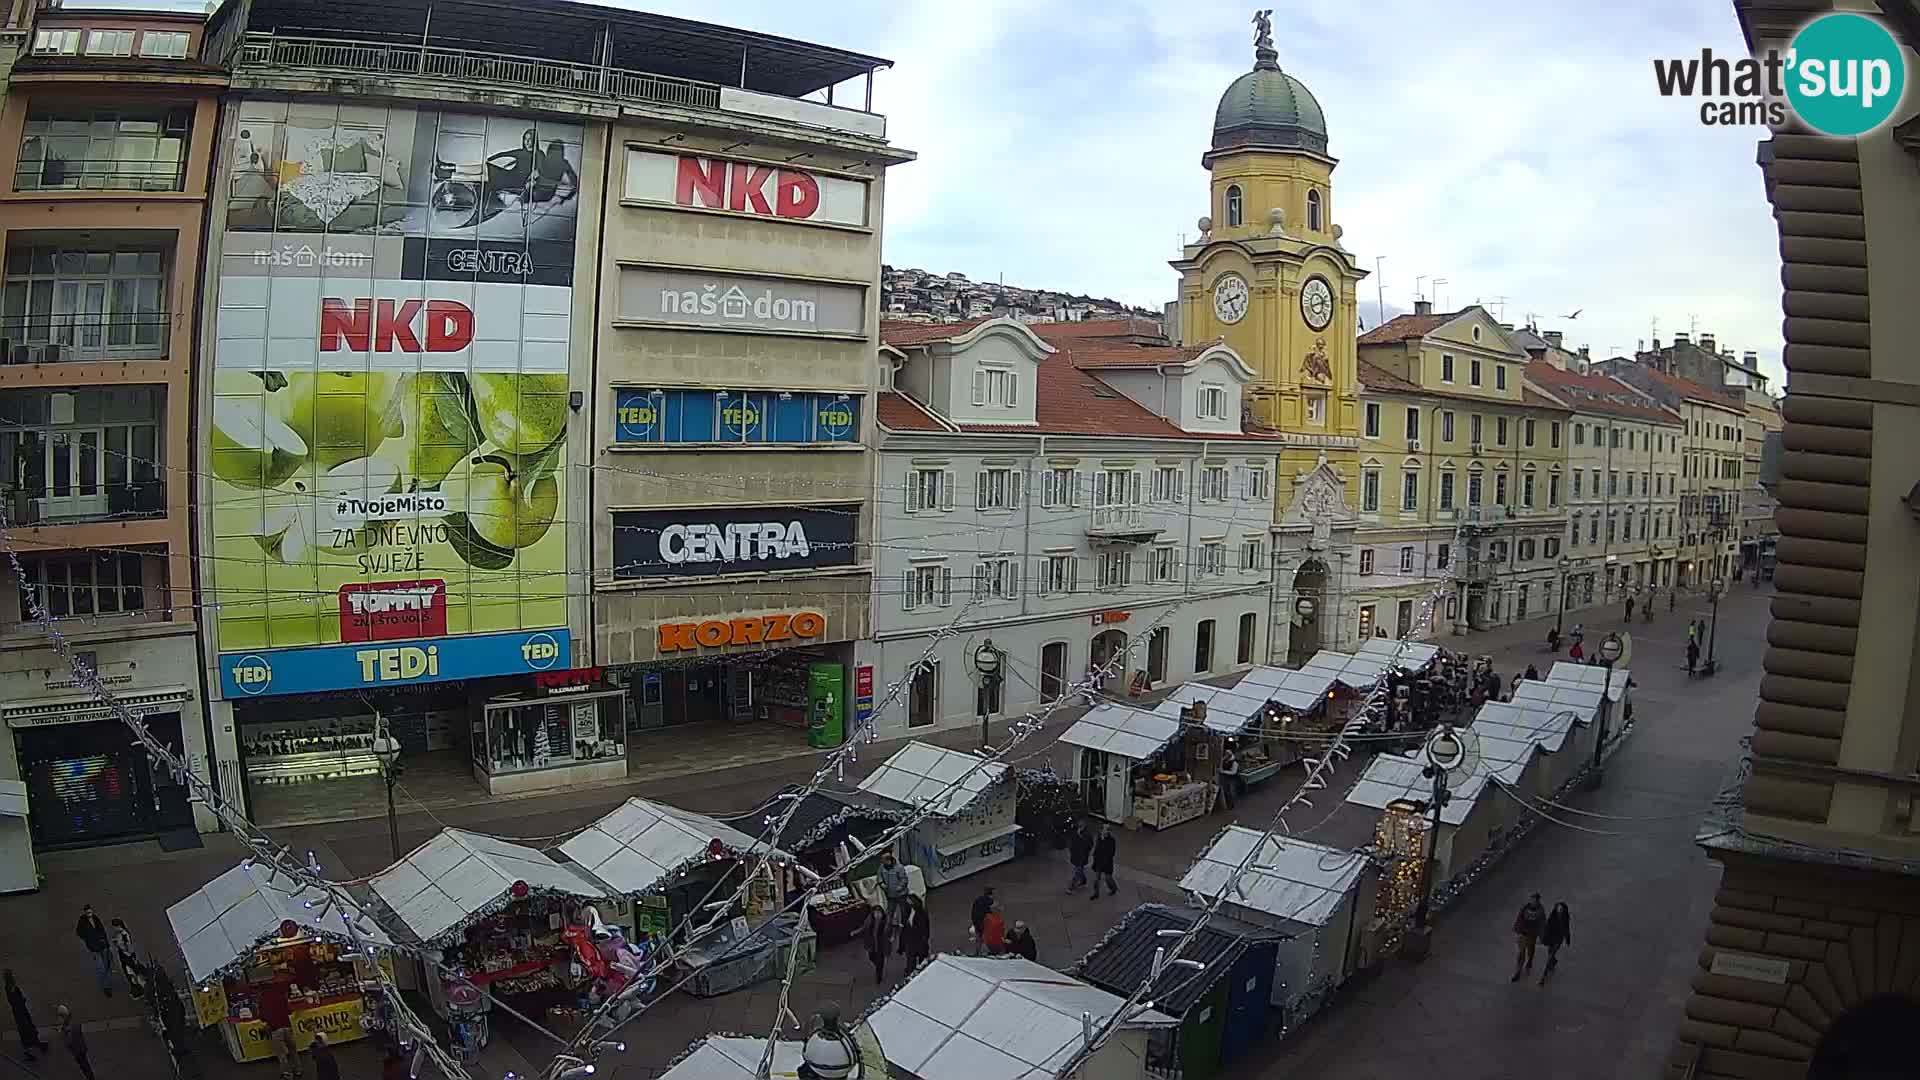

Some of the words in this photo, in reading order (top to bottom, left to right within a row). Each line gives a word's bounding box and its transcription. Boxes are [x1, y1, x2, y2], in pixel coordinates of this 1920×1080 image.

[675, 155, 820, 220] NKD
[253, 243, 293, 267] naš
[318, 246, 365, 268] dom
[447, 248, 534, 275] CENTRA
[661, 281, 717, 315] naš
[754, 288, 817, 322] dom
[319, 297, 477, 354] NKD
[618, 407, 657, 425] TEDi
[722, 408, 759, 426] TEDi
[819, 409, 853, 426] TEDi
[336, 495, 446, 516] #TvojeMisto
[332, 528, 356, 549] ZA
[365, 522, 450, 548] DNEVNO
[659, 520, 810, 564] CENTRA
[358, 547, 426, 575] SVJEŽE
[348, 584, 438, 614] TOMMY
[657, 611, 825, 652] KORZO
[357, 644, 439, 684] TEDi
[521, 642, 559, 661] TEDi
[231, 663, 272, 685] TEDi
